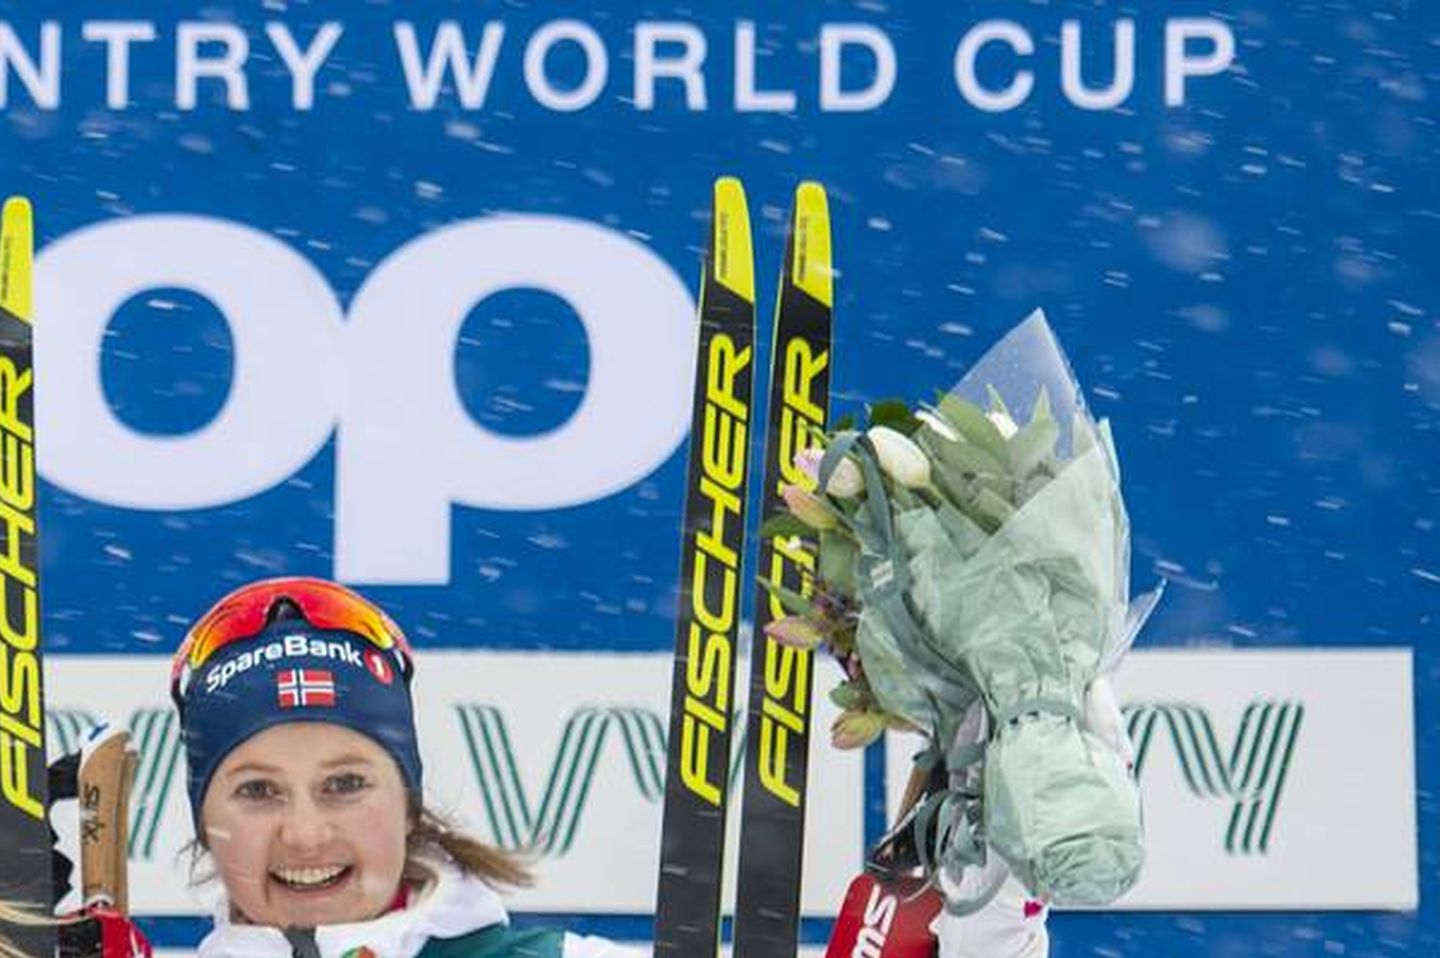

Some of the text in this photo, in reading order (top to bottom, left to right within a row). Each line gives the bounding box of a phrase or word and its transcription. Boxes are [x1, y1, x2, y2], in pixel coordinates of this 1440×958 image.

[394, 22, 897, 111] WORLD
[953, 21, 1236, 111] CUP
[679, 333, 753, 806] FISCHER
[205, 635, 364, 693] SpareBank
